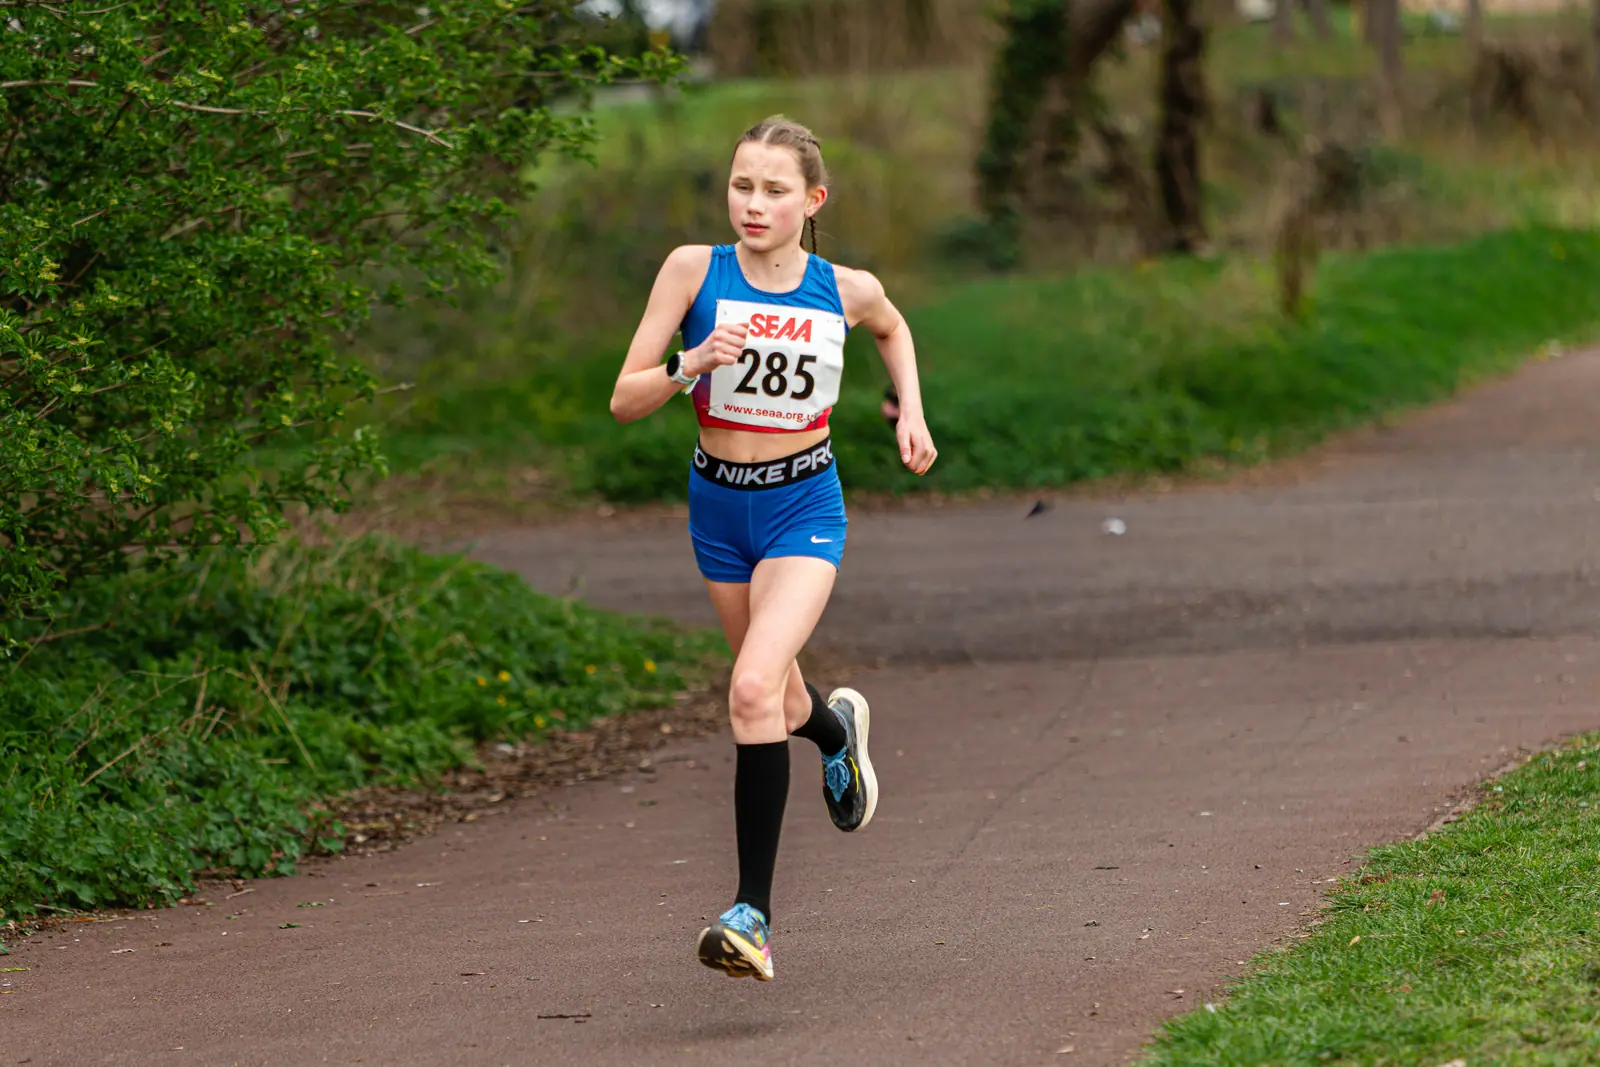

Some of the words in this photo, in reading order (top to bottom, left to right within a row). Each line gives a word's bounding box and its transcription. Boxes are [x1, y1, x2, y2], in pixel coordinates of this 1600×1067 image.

[749, 313, 813, 343] SEAA
[733, 348, 817, 400] 285
[723, 403, 817, 423] www.seaa.org.u
[715, 462, 787, 486] NIKE
